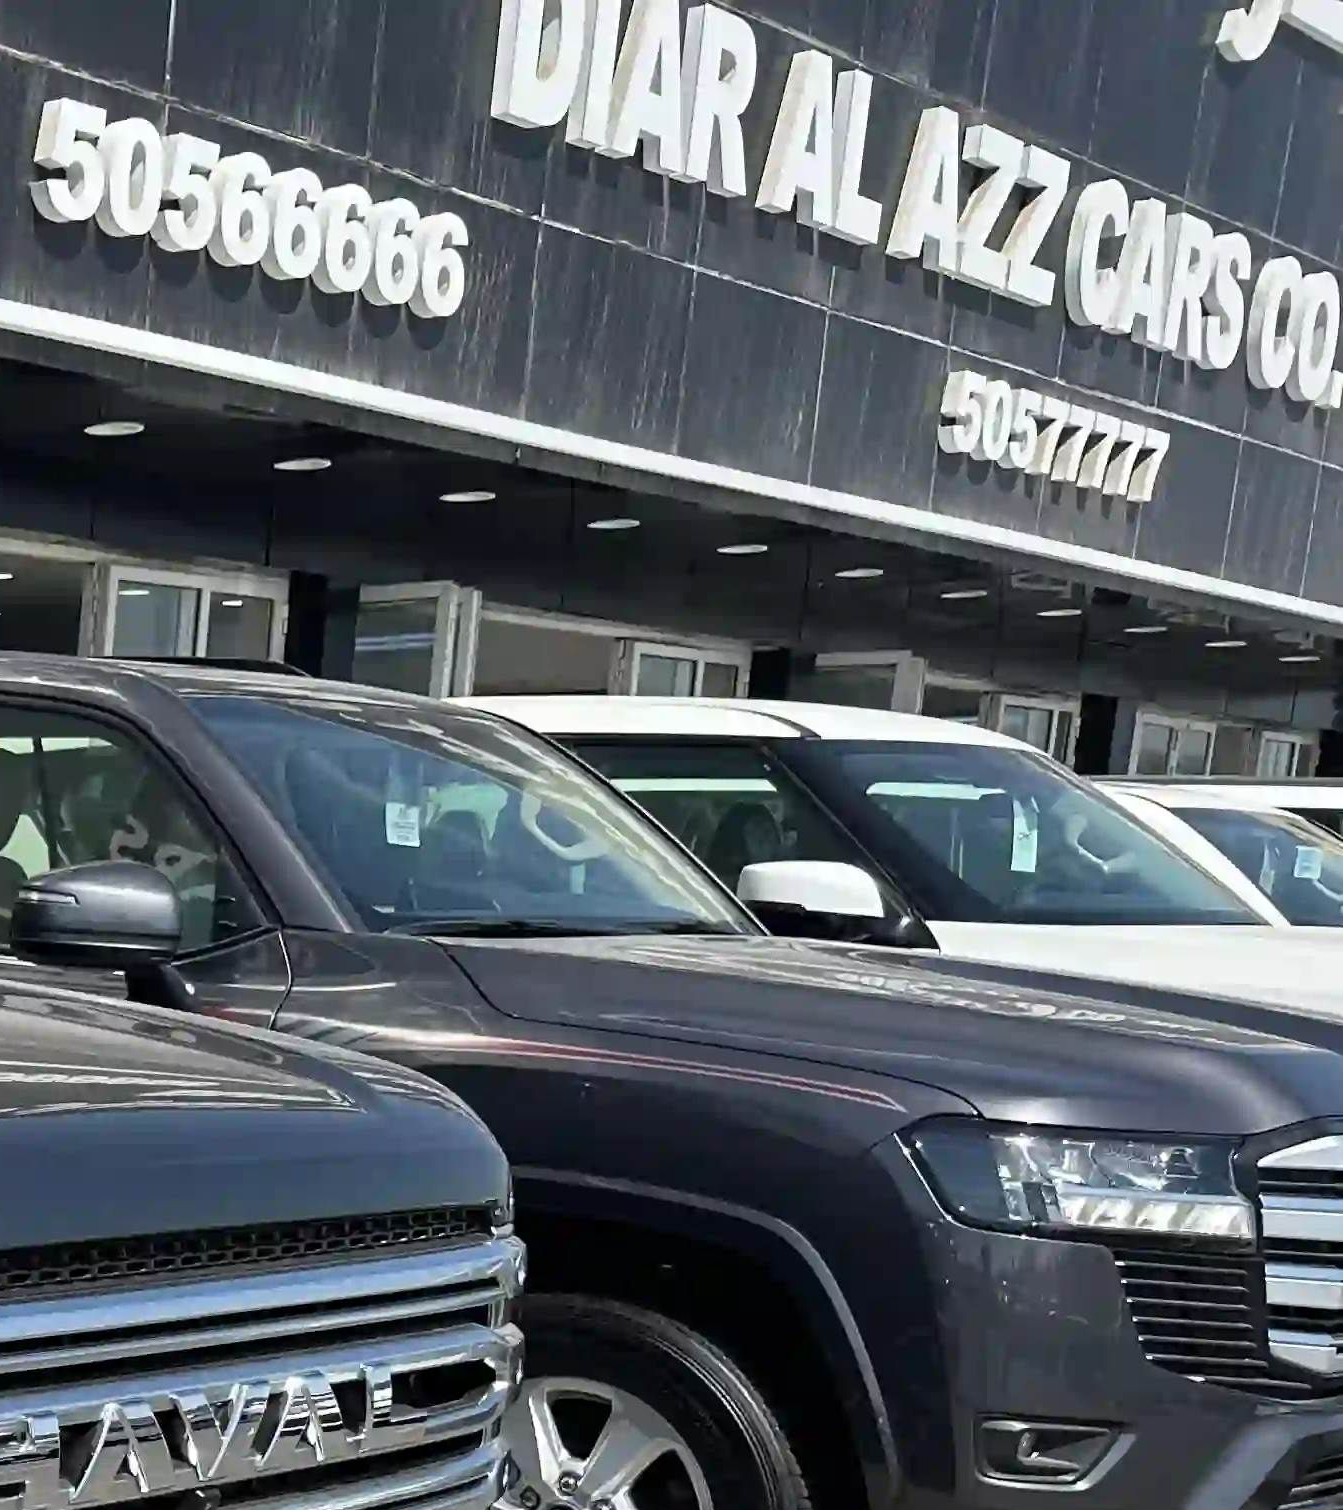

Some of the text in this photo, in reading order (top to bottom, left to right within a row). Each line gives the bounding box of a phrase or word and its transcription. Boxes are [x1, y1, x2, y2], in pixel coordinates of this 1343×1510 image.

[29, 98, 469, 319] 50566666
[490, 0, 757, 197] DIAR
[755, 49, 882, 245] AL
[885, 106, 1071, 307] AZZ
[1065, 178, 1251, 370] CARS
[938, 370, 1170, 502] 50577777
